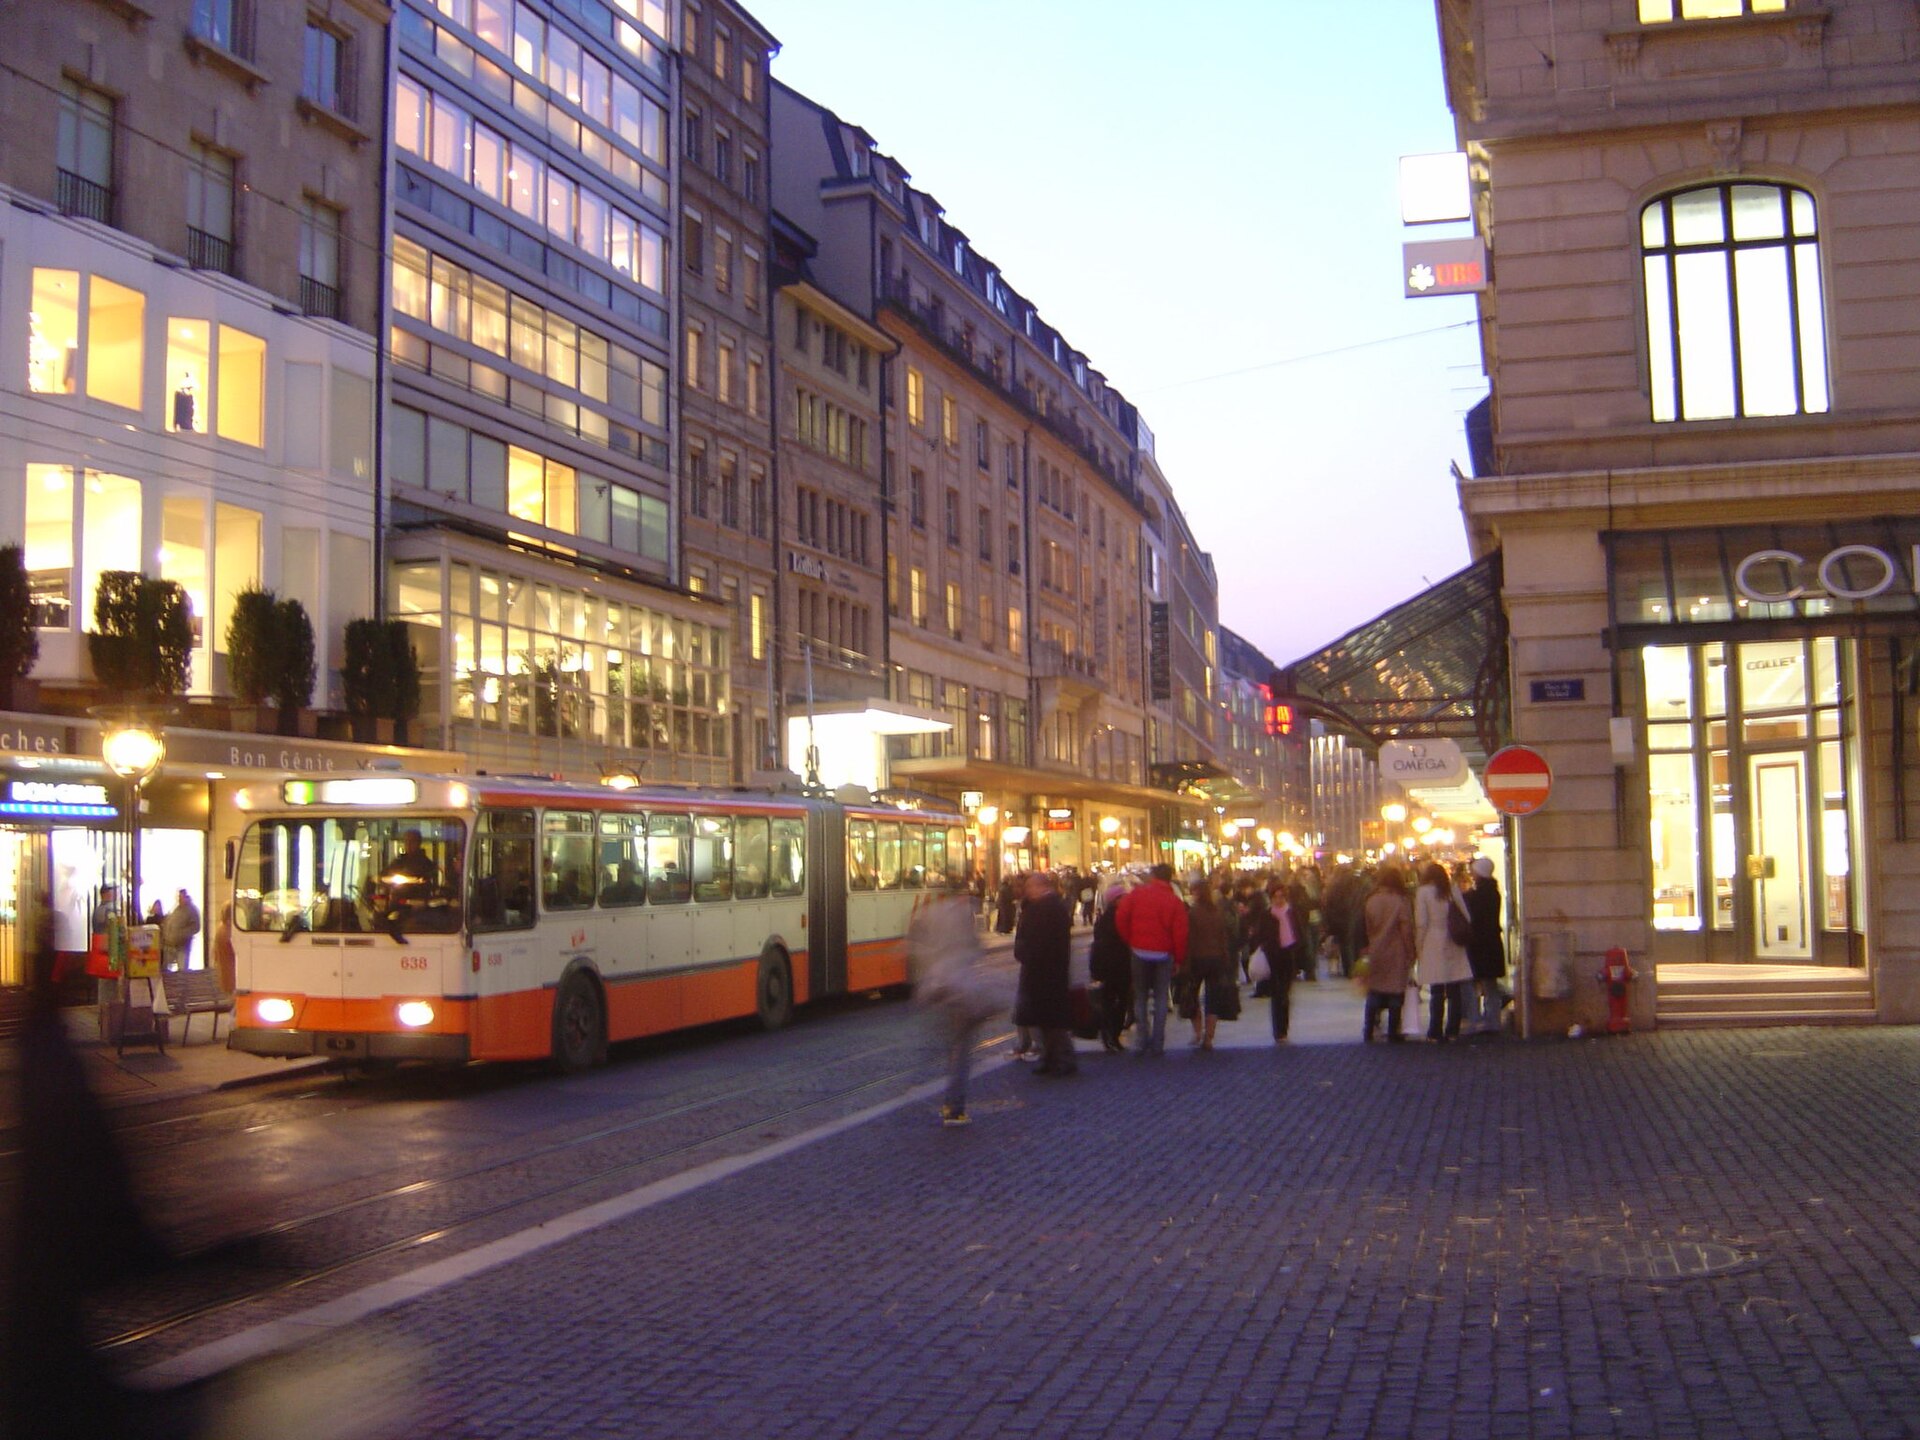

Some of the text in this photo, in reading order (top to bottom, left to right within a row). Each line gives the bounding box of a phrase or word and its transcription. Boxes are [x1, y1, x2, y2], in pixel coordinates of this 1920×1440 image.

[1436, 262, 1482, 286] UBS
[1735, 544, 1920, 602] CO
[1, 729, 60, 752] ches
[230, 747, 334, 772] Bon Génie
[1393, 758, 1447, 771] OMEGA
[401, 957, 427, 970] 638
